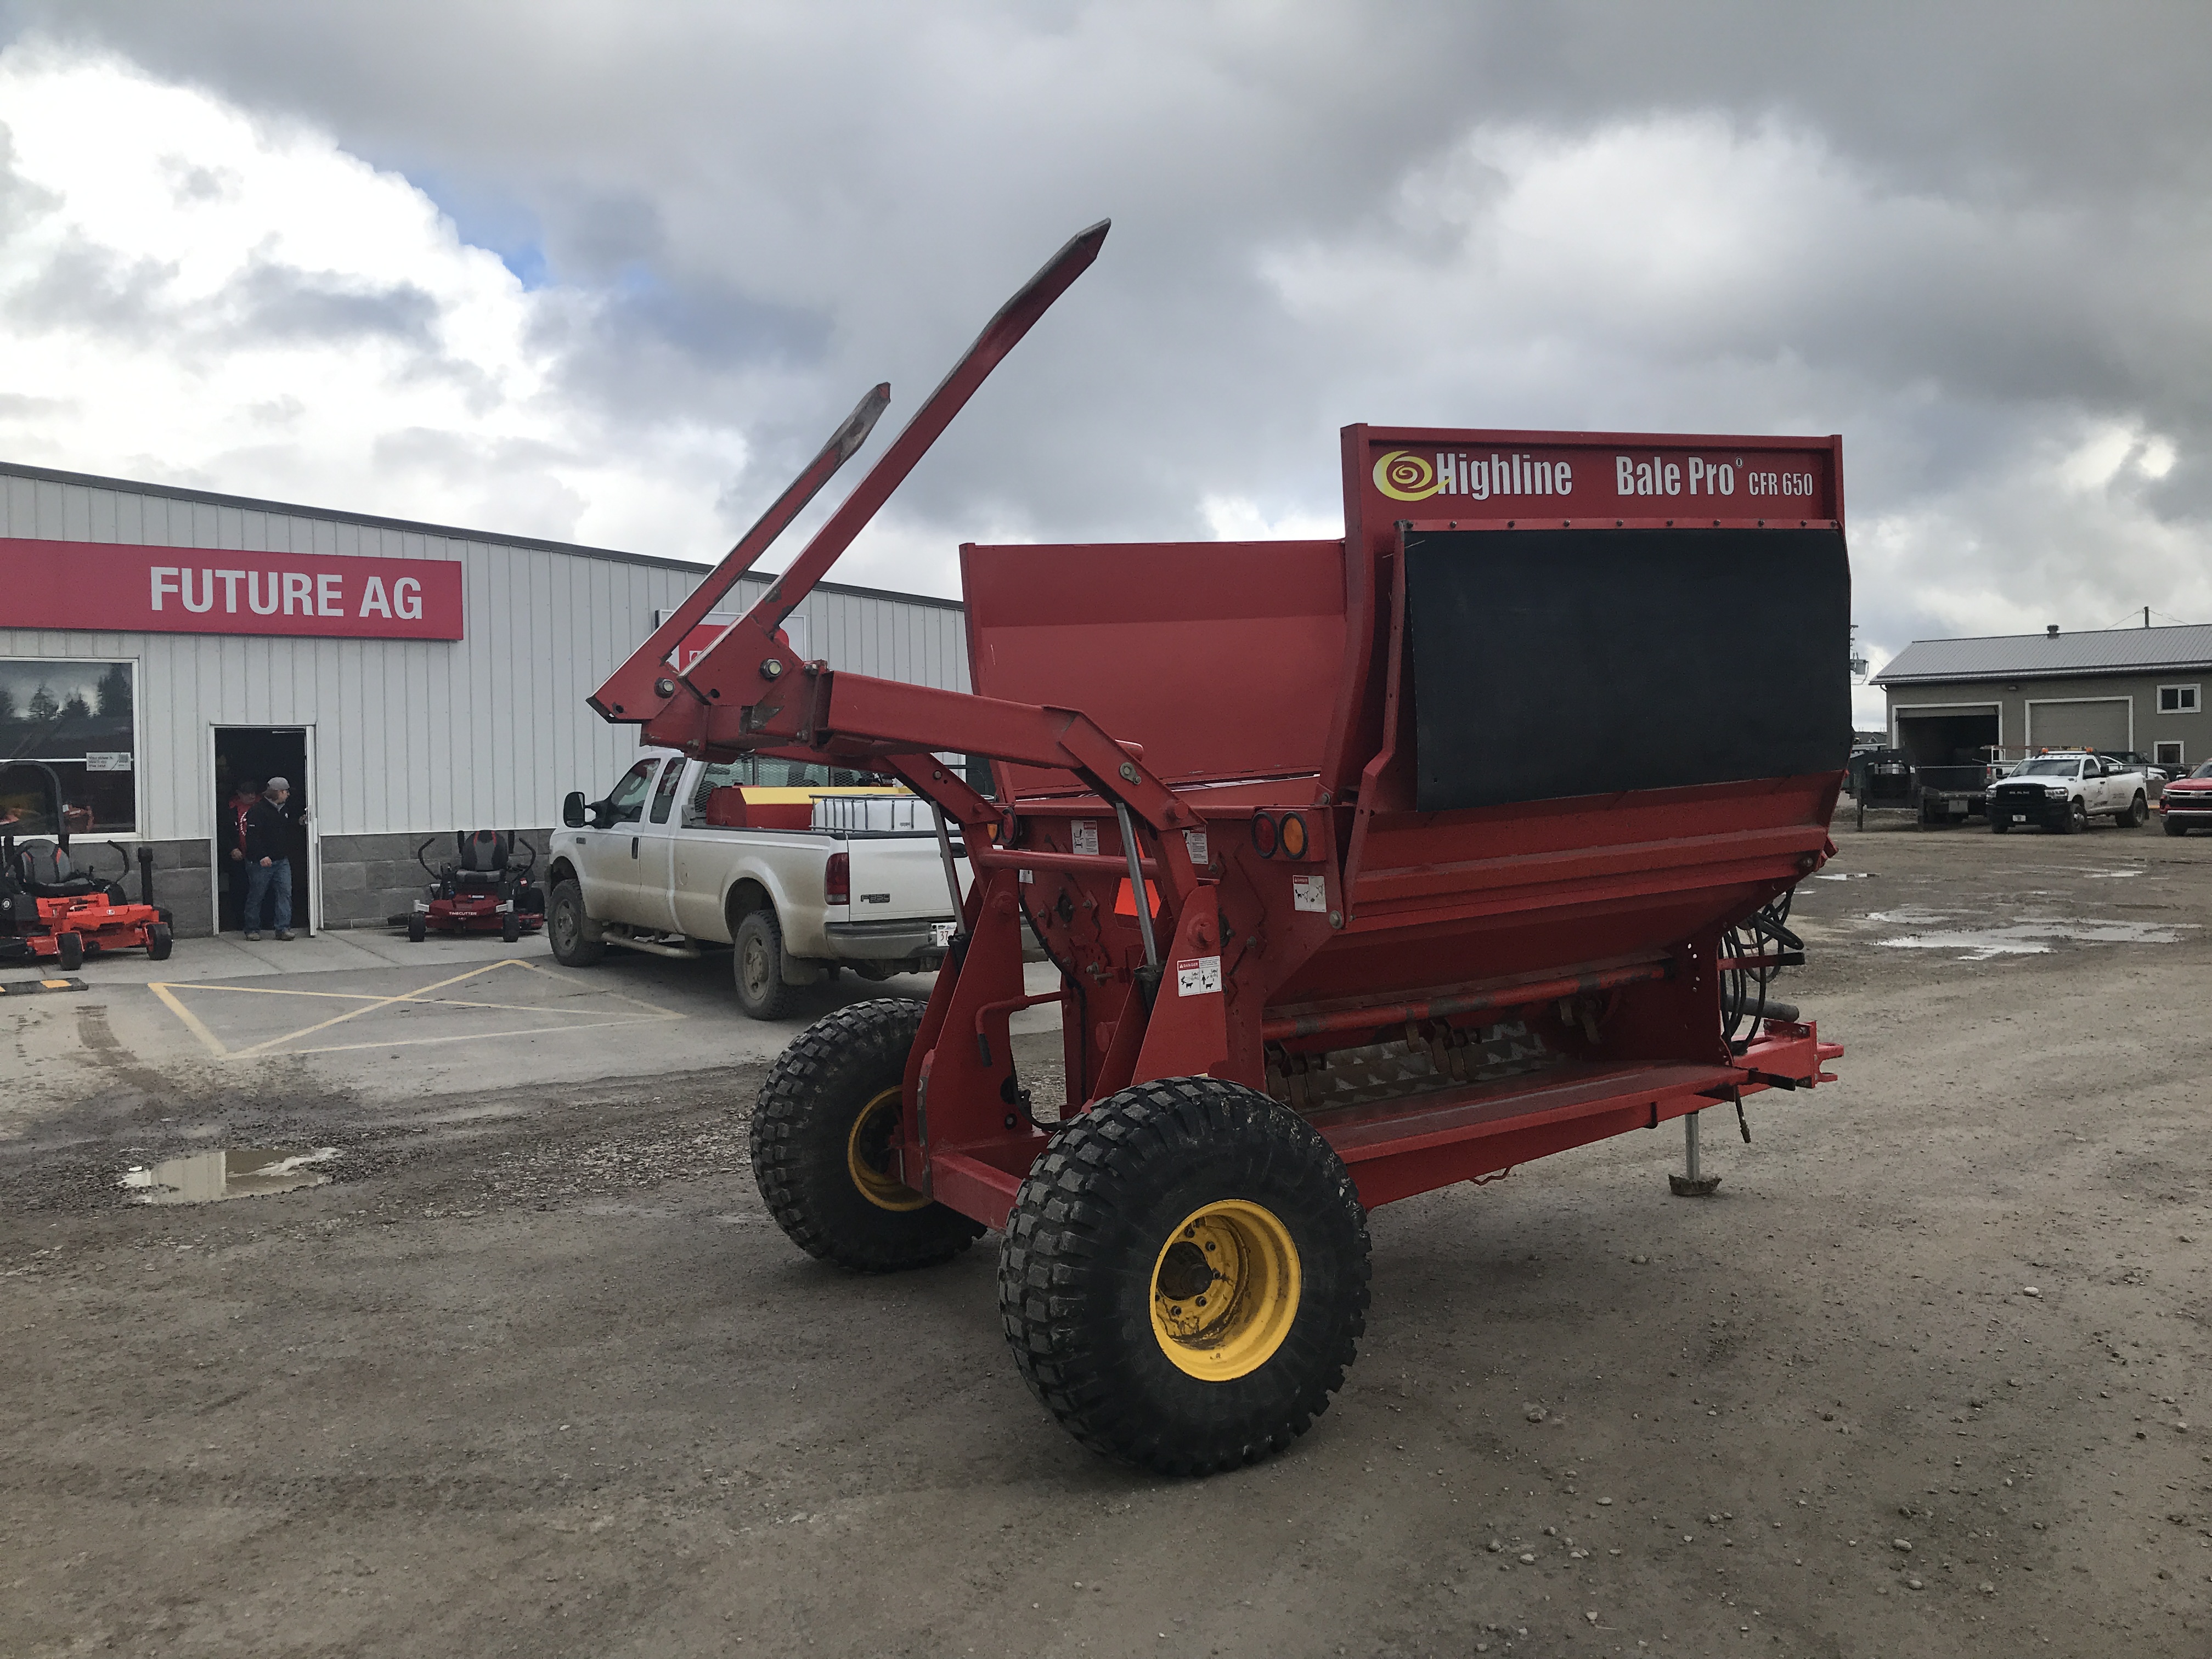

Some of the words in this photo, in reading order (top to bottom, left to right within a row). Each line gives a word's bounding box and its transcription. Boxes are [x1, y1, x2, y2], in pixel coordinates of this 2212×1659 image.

[1436, 453, 1572, 500] Highline
[1616, 456, 1681, 495] Bale
[1749, 472, 1778, 495] CFR
[1782, 472, 1813, 496] 650
[151, 567, 344, 617] FUTURE
[359, 576, 422, 619] AG
